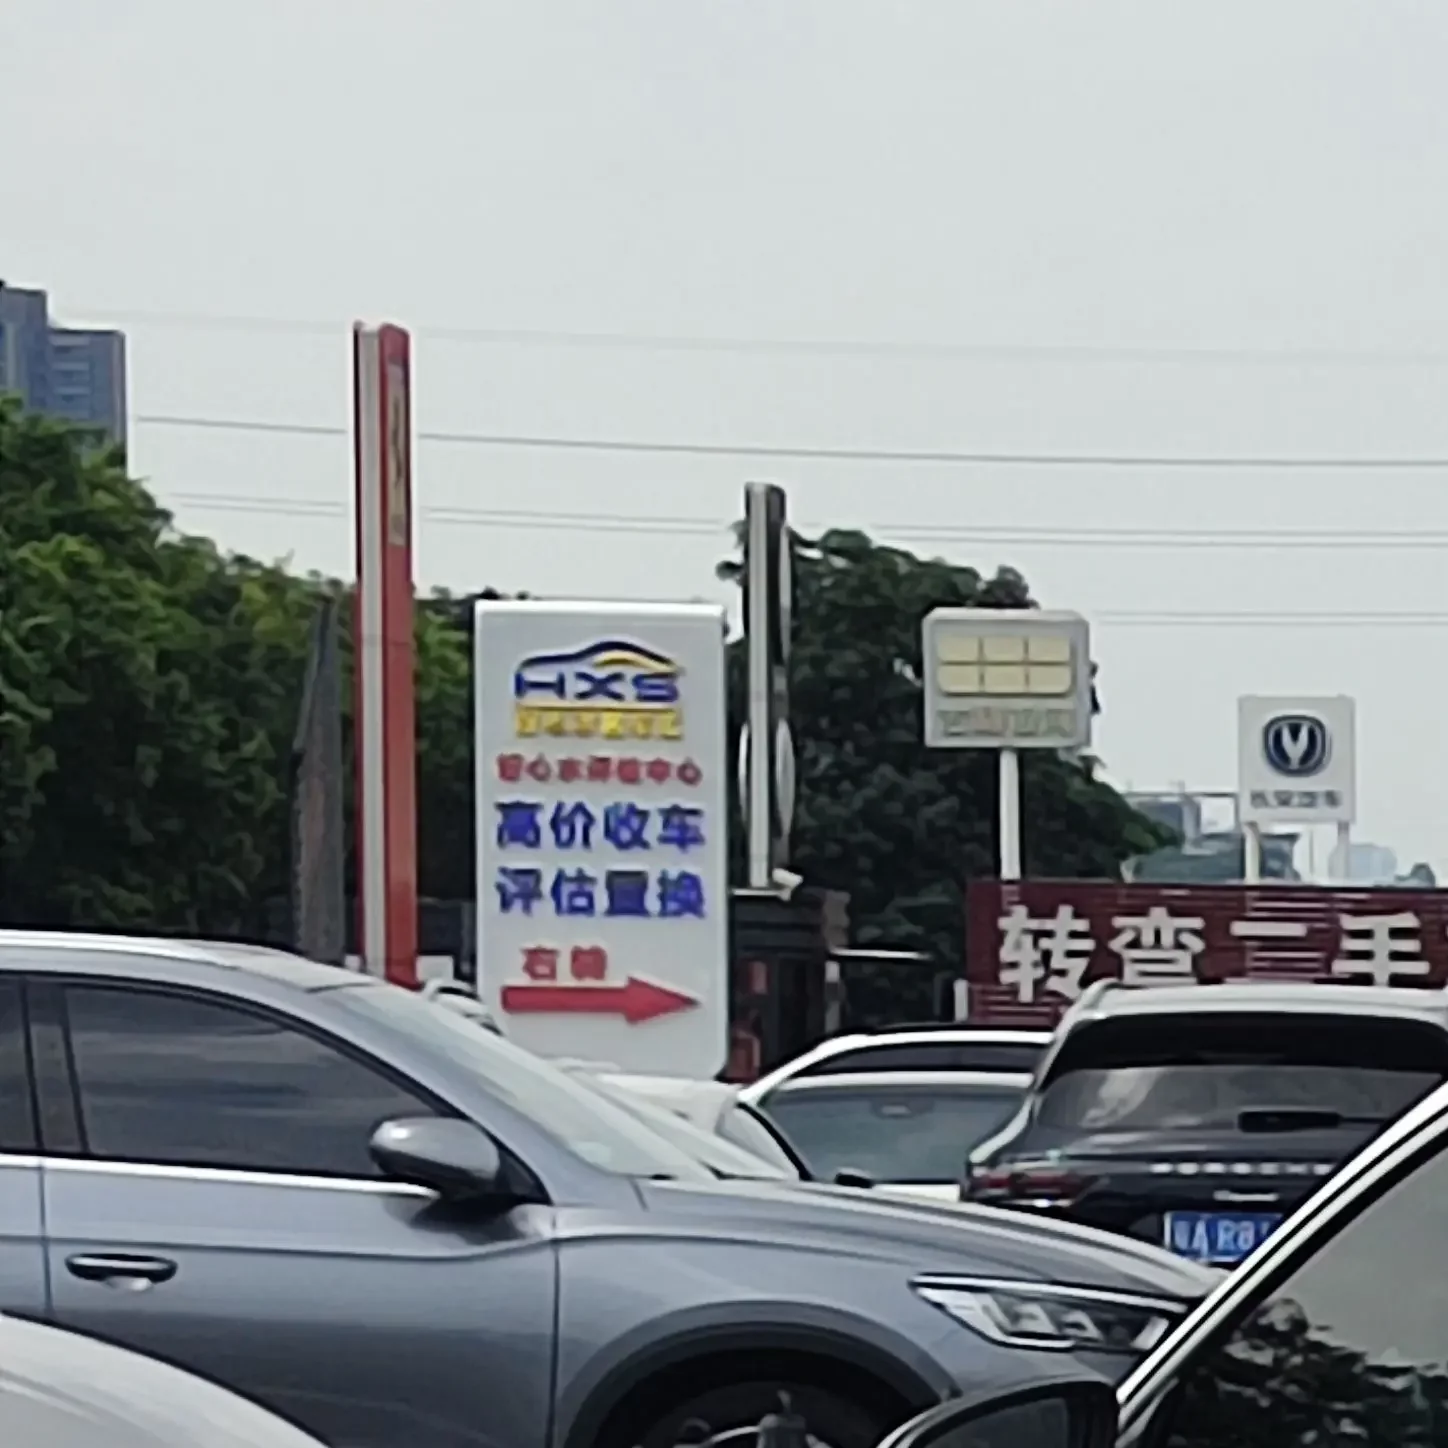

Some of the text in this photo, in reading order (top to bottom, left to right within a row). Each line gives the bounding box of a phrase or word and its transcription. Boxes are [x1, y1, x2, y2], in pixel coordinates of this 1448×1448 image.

[514, 671, 680, 702] HXS
[495, 801, 706, 852] 高价收车
[495, 866, 706, 919] 评估置换
